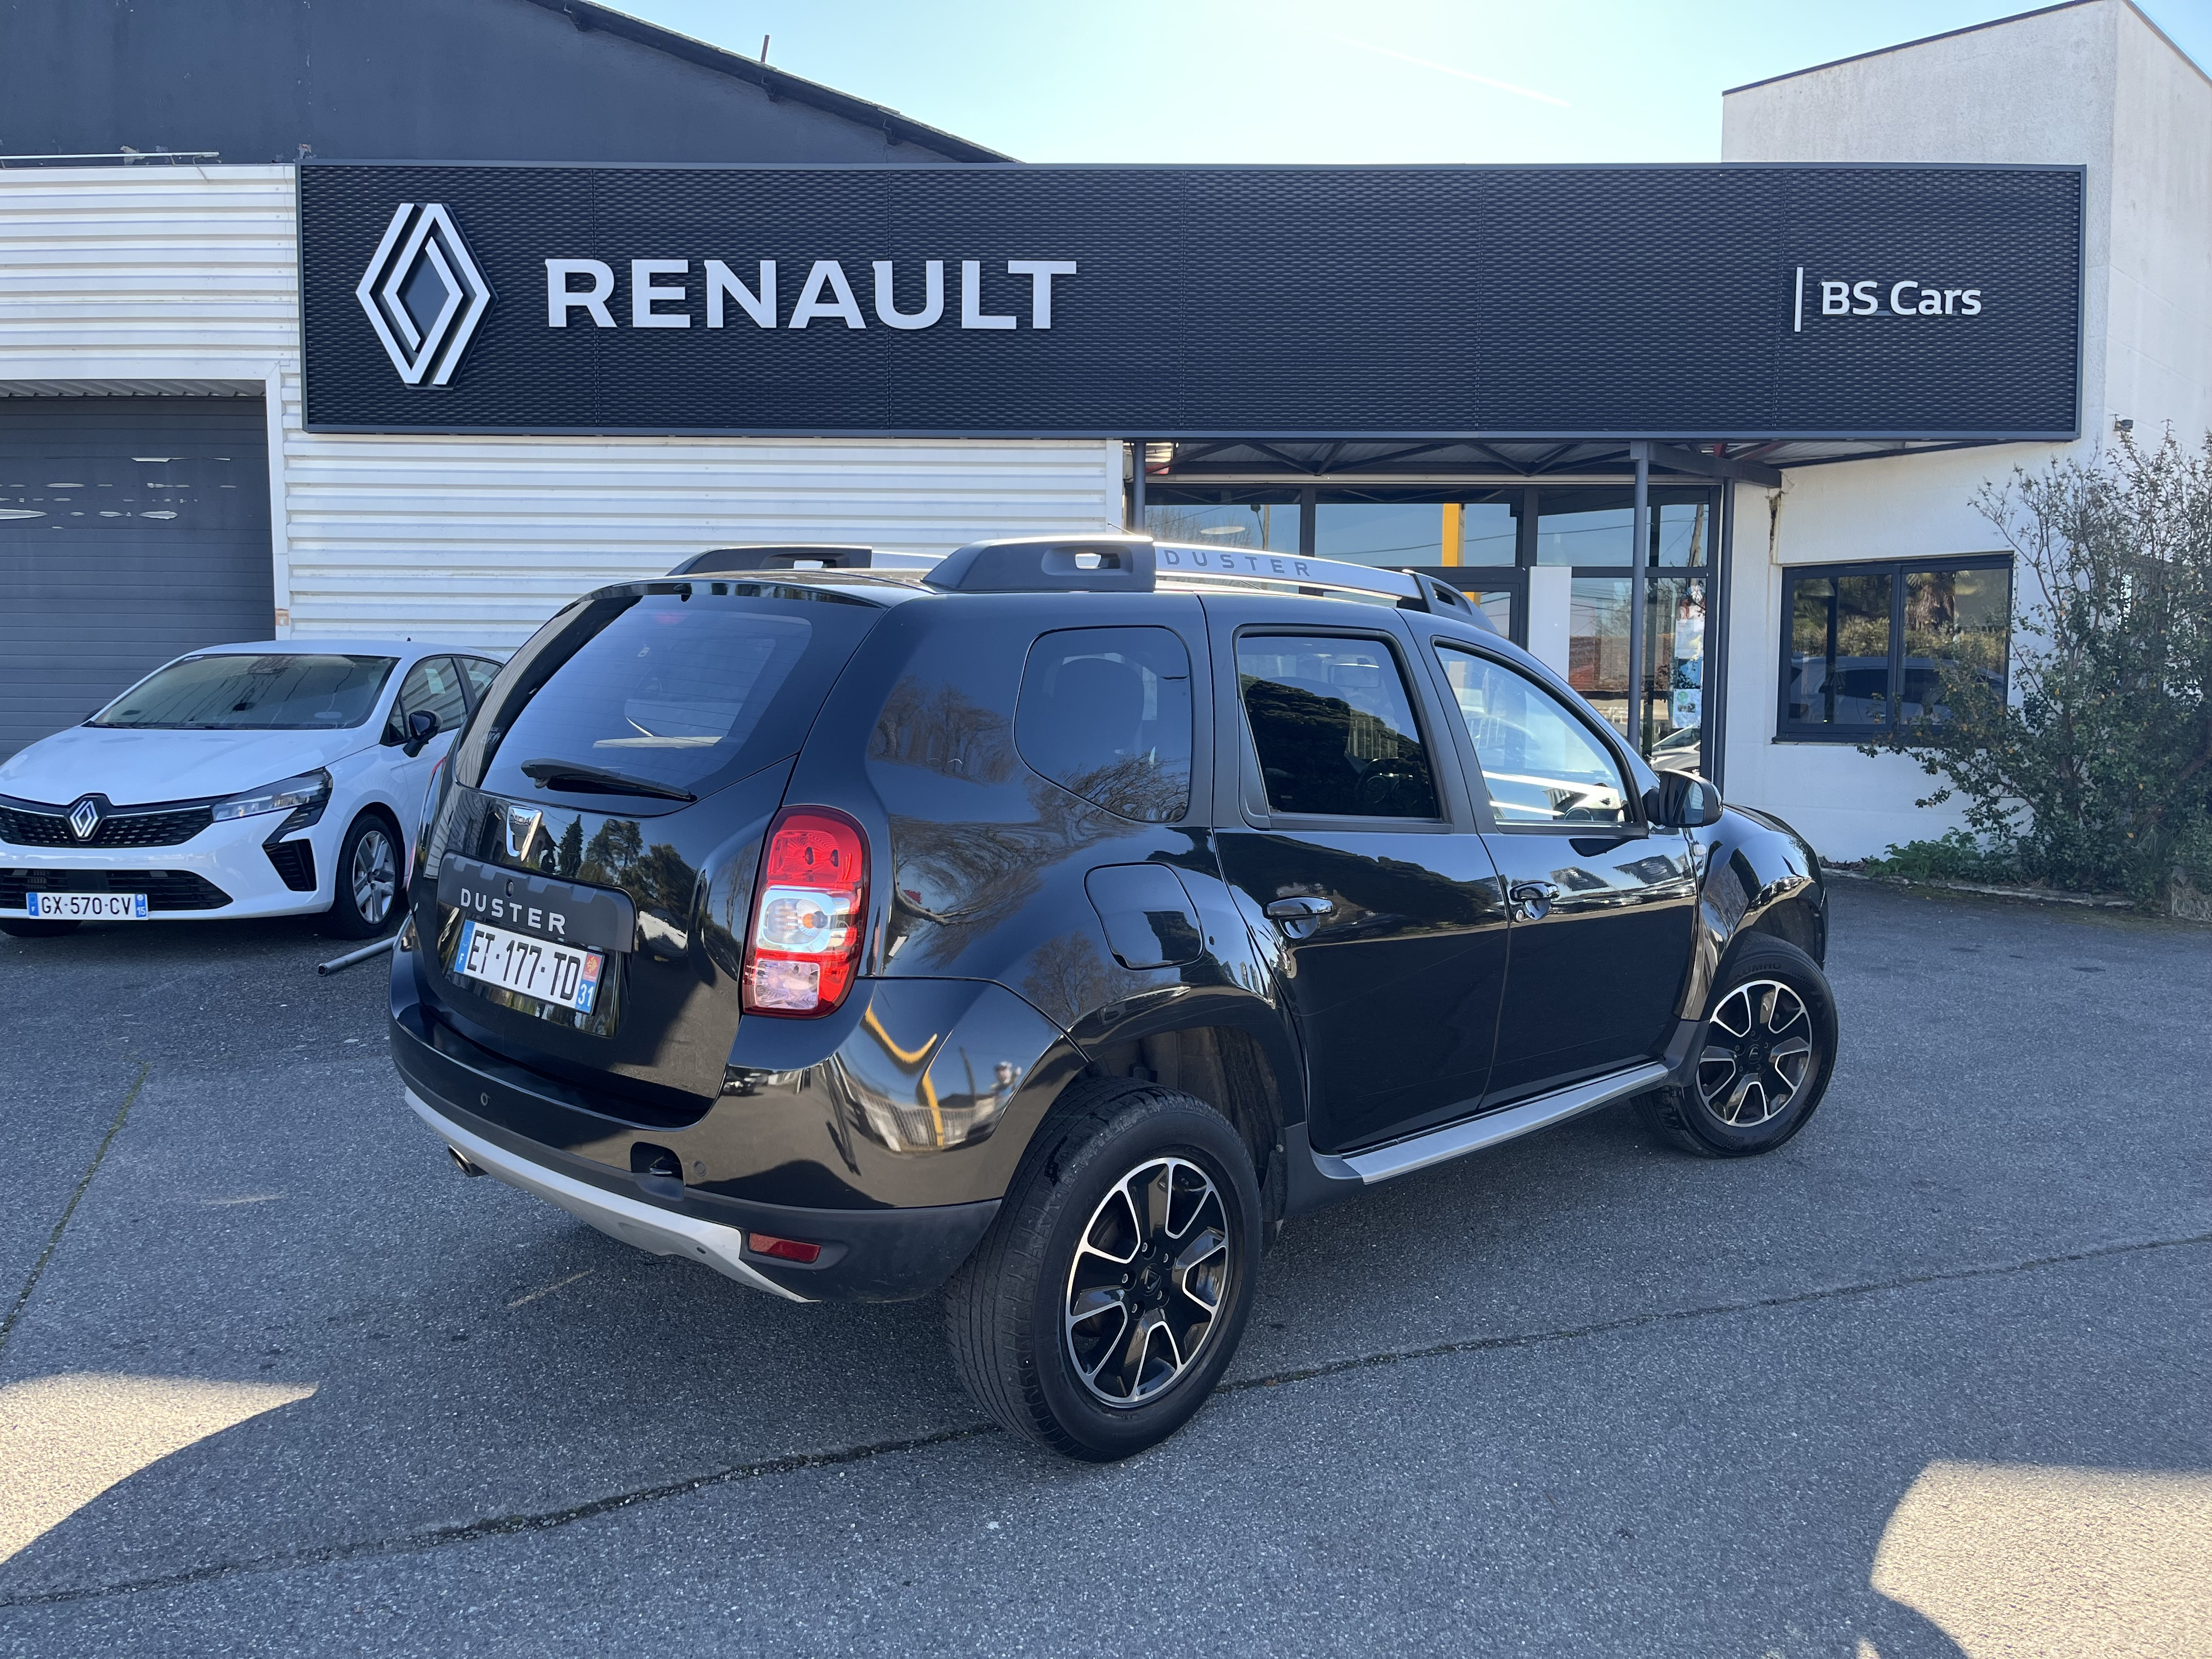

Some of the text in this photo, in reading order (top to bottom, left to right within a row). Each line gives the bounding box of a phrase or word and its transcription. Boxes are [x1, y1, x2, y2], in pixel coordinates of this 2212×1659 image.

[545, 259, 1077, 329] RENAULT
[1821, 280, 1982, 315] BS Cars
[1164, 549, 1310, 577] DUSTER
[41, 896, 131, 915] GX-570-CV
[137, 906, 146, 916] 15
[460, 888, 566, 935] DUSTER
[458, 953, 465, 964] F
[467, 930, 581, 1001] ET-177-TD
[578, 983, 594, 1007] 31
